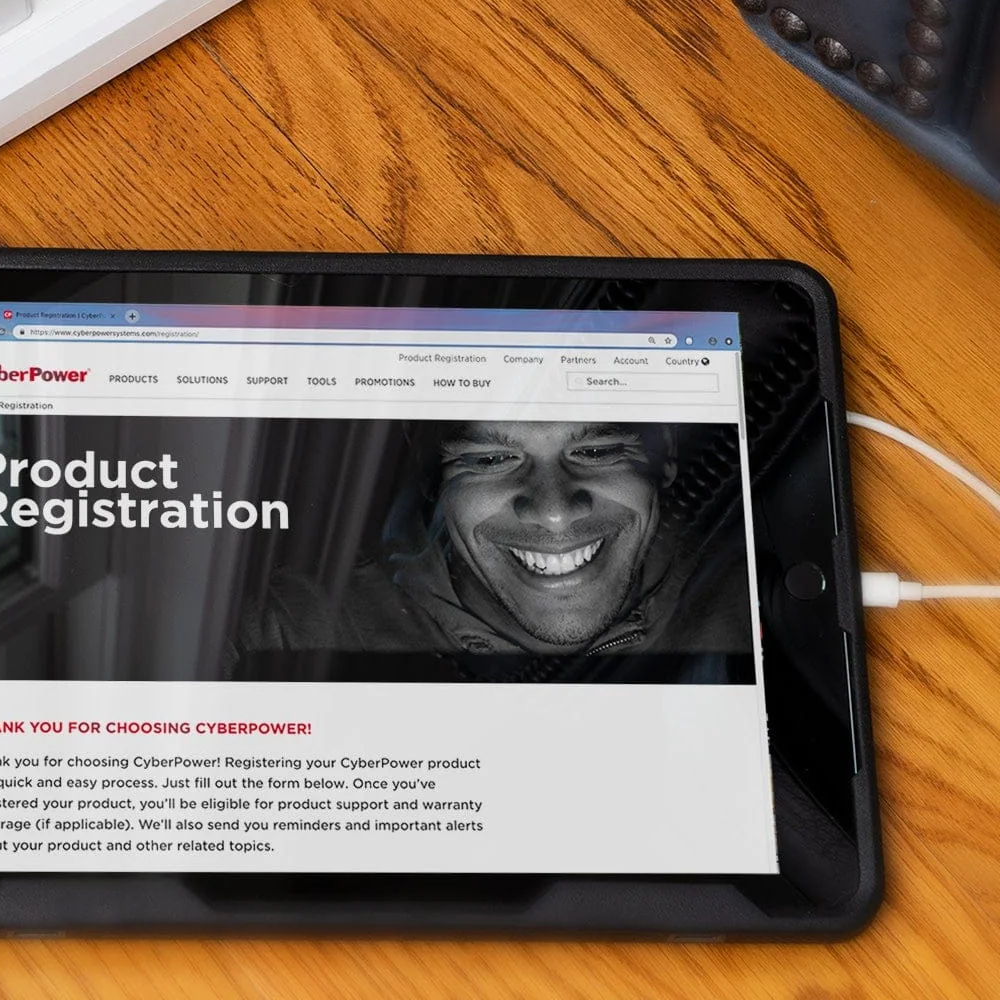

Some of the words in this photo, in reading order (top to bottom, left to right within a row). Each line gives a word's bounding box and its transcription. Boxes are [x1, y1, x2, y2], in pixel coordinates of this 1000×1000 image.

[399, 354, 432, 363] Product
[435, 354, 486, 365] Registration
[504, 355, 543, 366] Company
[561, 356, 596, 365] Partners
[614, 356, 648, 366] Account
[665, 357, 699, 368] Country
[109, 375, 158, 384] PRODUCTS
[177, 376, 228, 385] SOLUTIONS
[247, 376, 288, 385] SUPPORT
[307, 377, 337, 386] TOOLS
[355, 378, 415, 387] PROMOTIONS
[433, 379, 455, 387] HOW
[459, 379, 470, 387] TO
[473, 379, 491, 388] BUY
[586, 377, 627, 386] Search...
[30, 722, 63, 734] YOU
[68, 722, 101, 734] FOR
[106, 722, 191, 734] CHOOSING
[196, 723, 311, 735] CYBERPOWER!
[14, 758, 39, 768] you
[44, 756, 63, 767] for
[67, 756, 129, 769] choosing
[133, 756, 221, 769] CyberPower!
[225, 756, 302, 770] Registering
[306, 759, 336, 770] your
[341, 757, 423, 770] CyberPower
[428, 758, 481, 770] product
[37, 777, 62, 788] and
[67, 780, 97, 790] easy
[102, 778, 157, 790] process.
[162, 778, 190, 789] Just
[194, 777, 210, 789] fill
[215, 779, 237, 789] out
[242, 778, 263, 789] the
[268, 778, 299, 789] form
[304, 778, 348, 789] below.
[353, 779, 388, 789] Once
[392, 779, 436, 791] you've
[43, 800, 73, 811] your
[78, 798, 135, 811] product,
[140, 798, 175, 811] you'll
[180, 798, 197, 809] be
[201, 799, 250, 812] eligible
[255, 799, 273, 810] for
[278, 799, 331, 812] product
[336, 800, 388, 812] support
[393, 800, 418, 811] and
[422, 800, 482, 812] warranty
[35, 819, 50, 831] (if
[55, 819, 134, 832] applicable).
[139, 819, 171, 830] We'll
[176, 819, 203, 831] also
[207, 820, 239, 831] send
[244, 822, 268, 832] you
[273, 820, 341, 831] reminders
[345, 820, 370, 831] and
[375, 820, 441, 833] important
[446, 820, 483, 832] alerts
[12, 842, 43, 852] your
[48, 840, 101, 852] product
[106, 840, 131, 851] and
[136, 840, 172, 851] other
[177, 841, 224, 852] related
[229, 841, 274, 853] topics.
